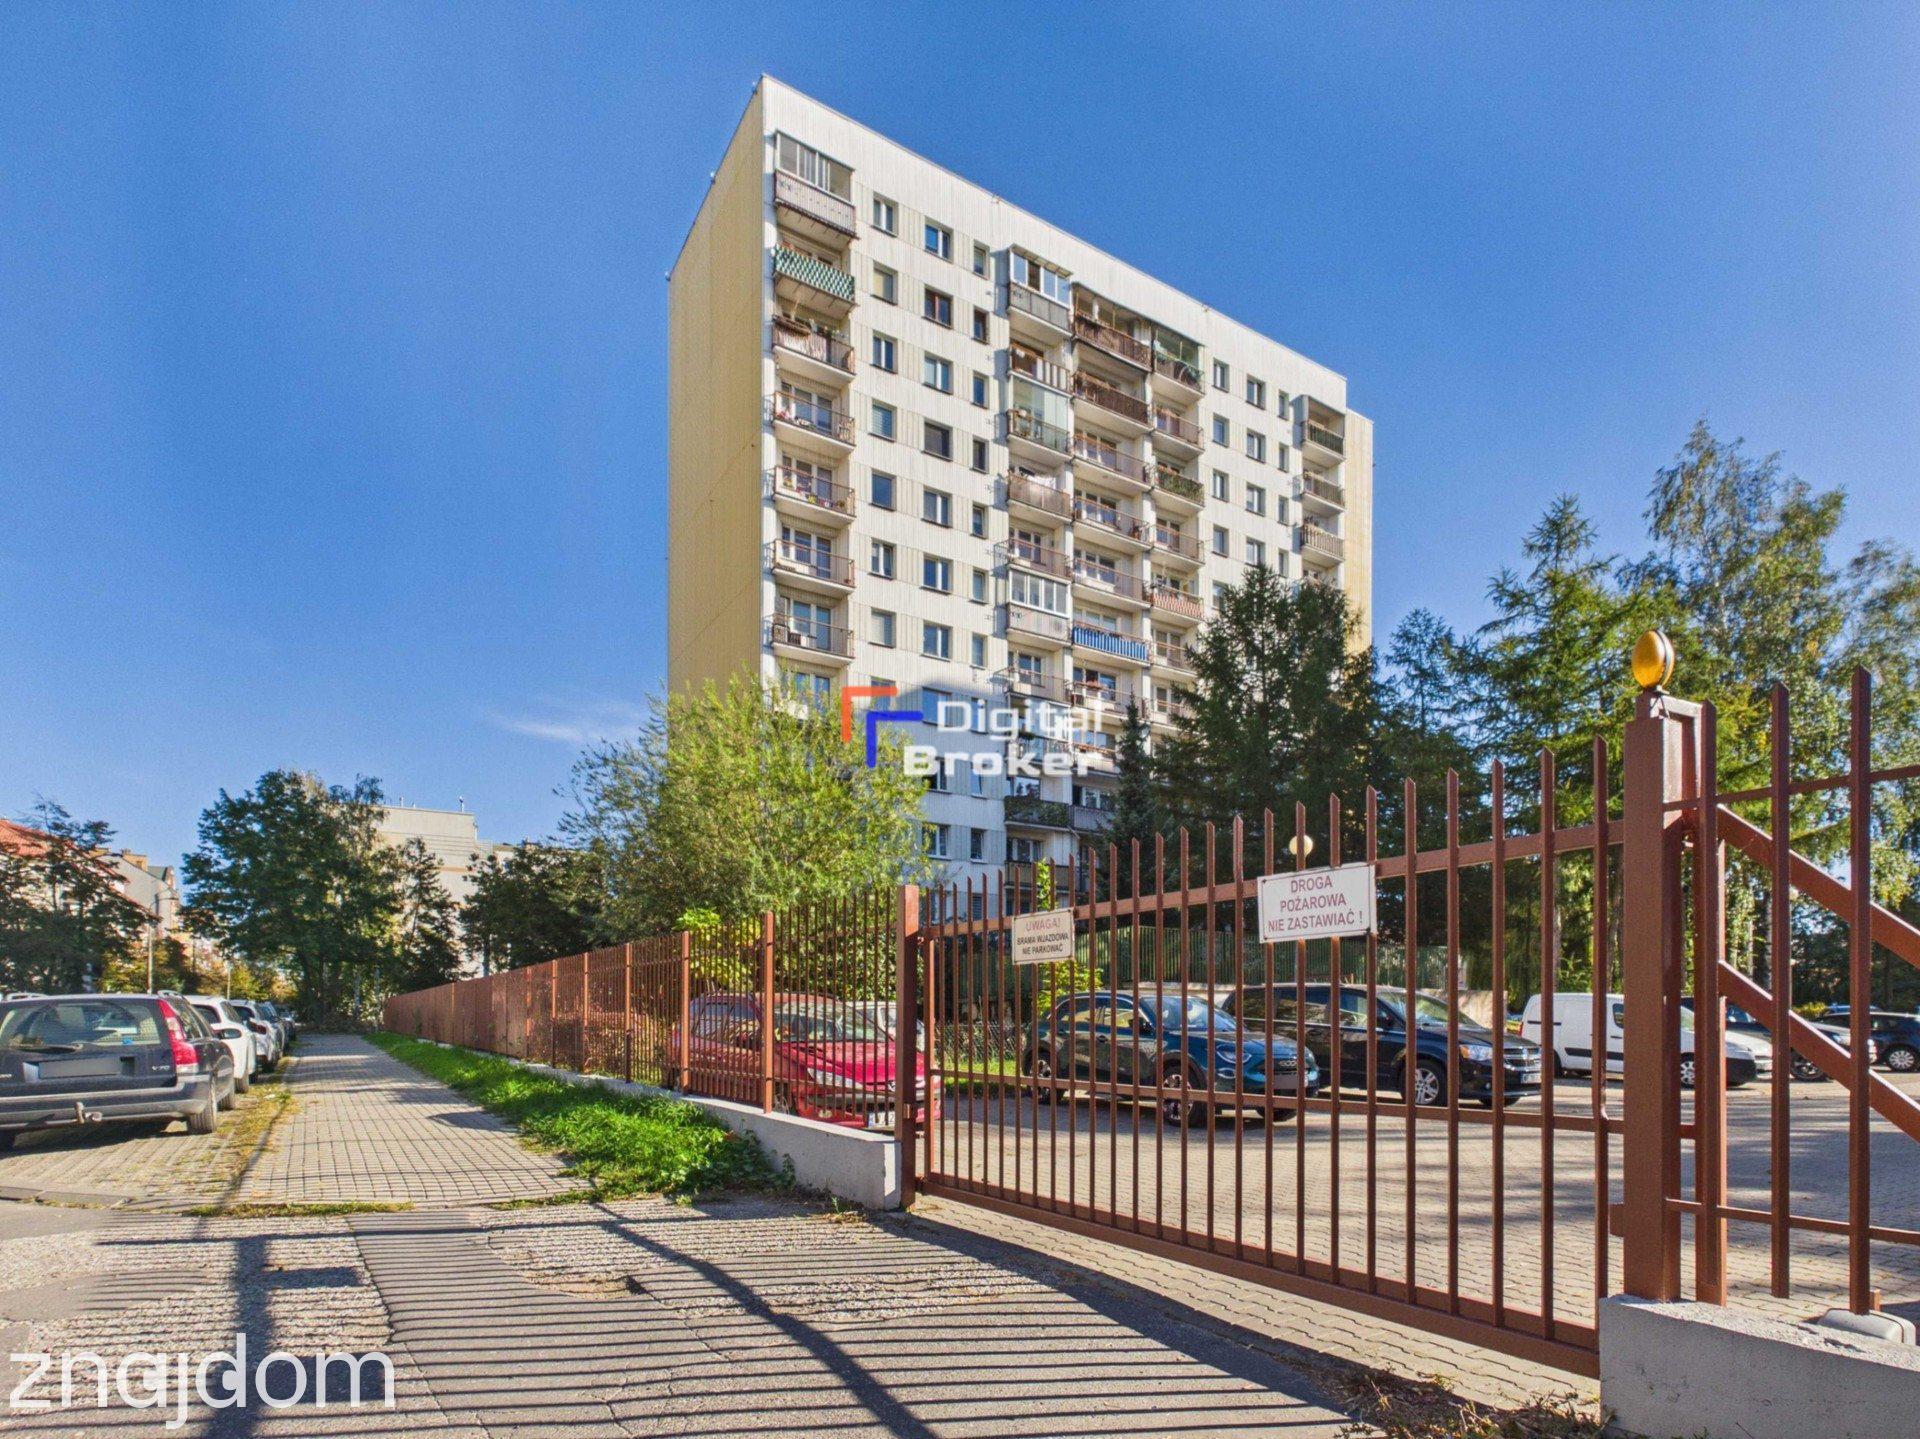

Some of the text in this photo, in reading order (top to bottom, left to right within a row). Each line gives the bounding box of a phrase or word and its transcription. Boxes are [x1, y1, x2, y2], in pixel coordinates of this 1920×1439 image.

[1290, 875, 1333, 893] DROGA
[1281, 893, 1346, 912] POŻAROWA
[1026, 918, 1060, 931] UWAGA!
[1268, 909, 1363, 932] NIE ZASTAWIAĆ !
[1022, 946, 1031, 955] NIE
